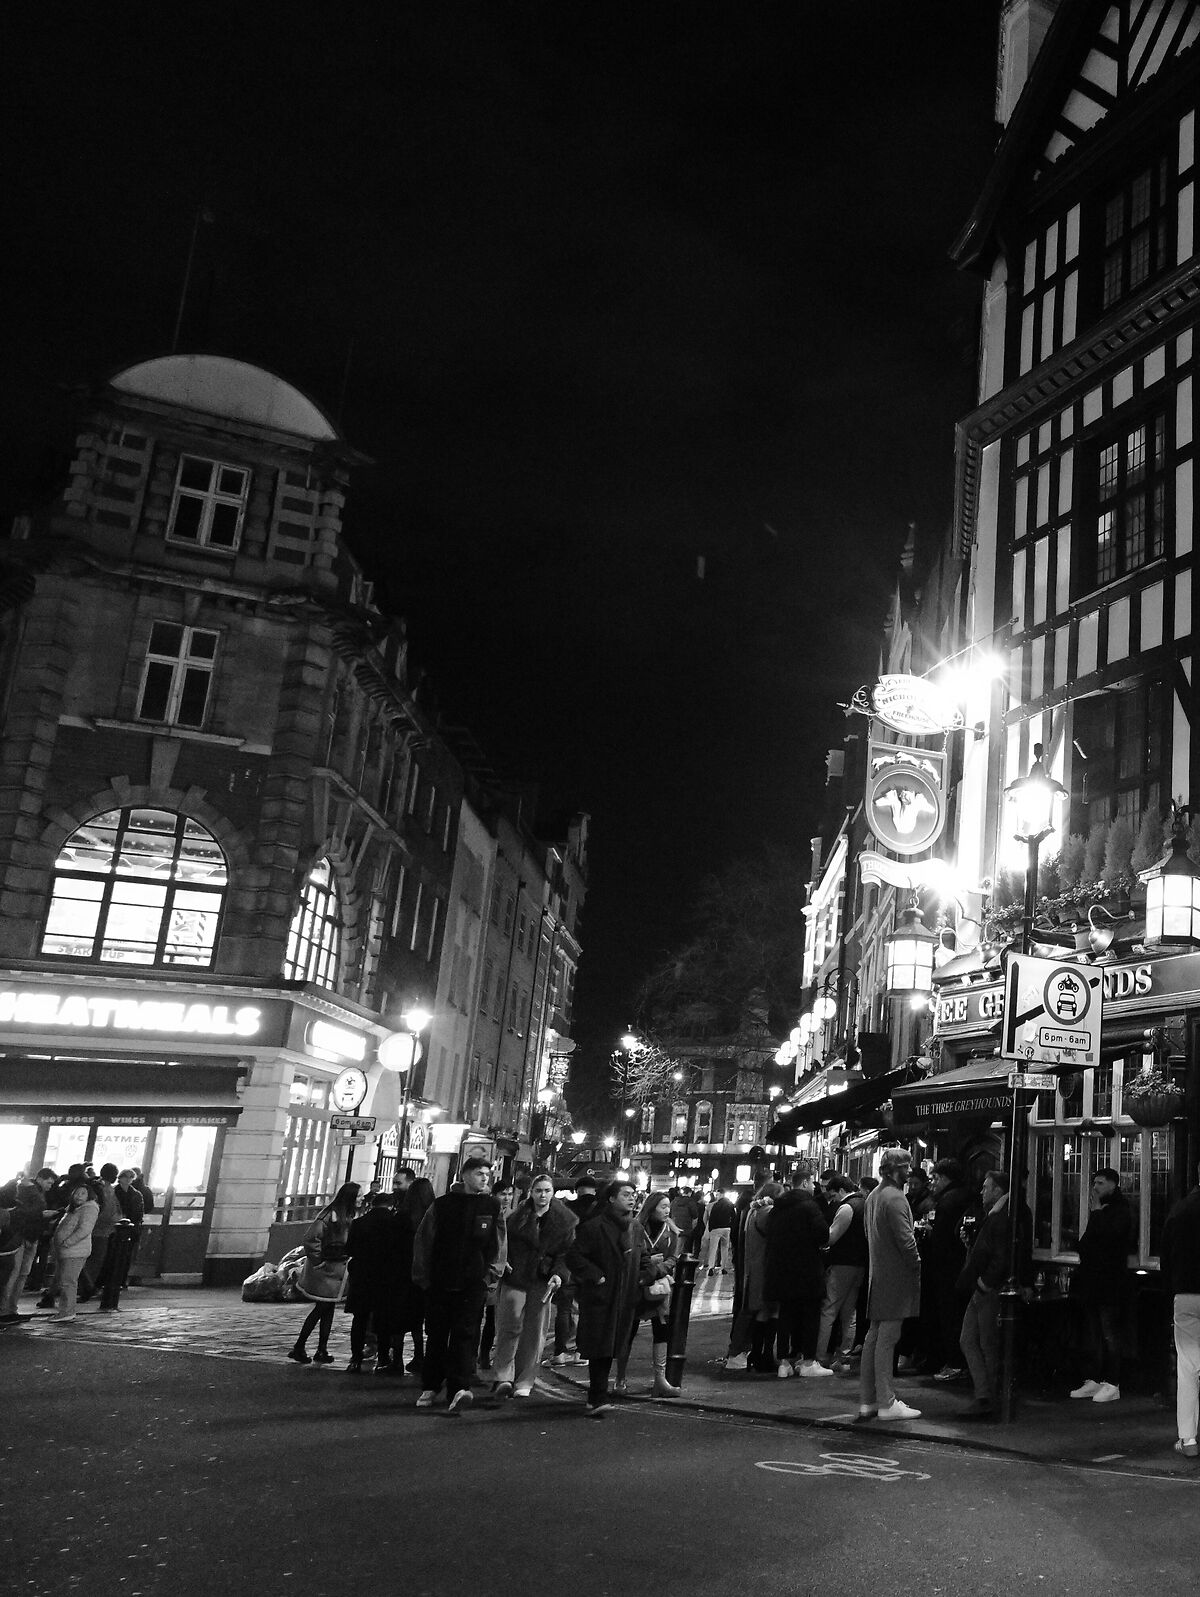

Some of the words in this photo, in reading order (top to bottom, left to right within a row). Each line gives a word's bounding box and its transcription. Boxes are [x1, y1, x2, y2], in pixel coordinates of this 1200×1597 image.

[916, 1105, 930, 1116] THE
[931, 1101, 954, 1114] THREE
[954, 1095, 1013, 1112] GREYHOUNDS
